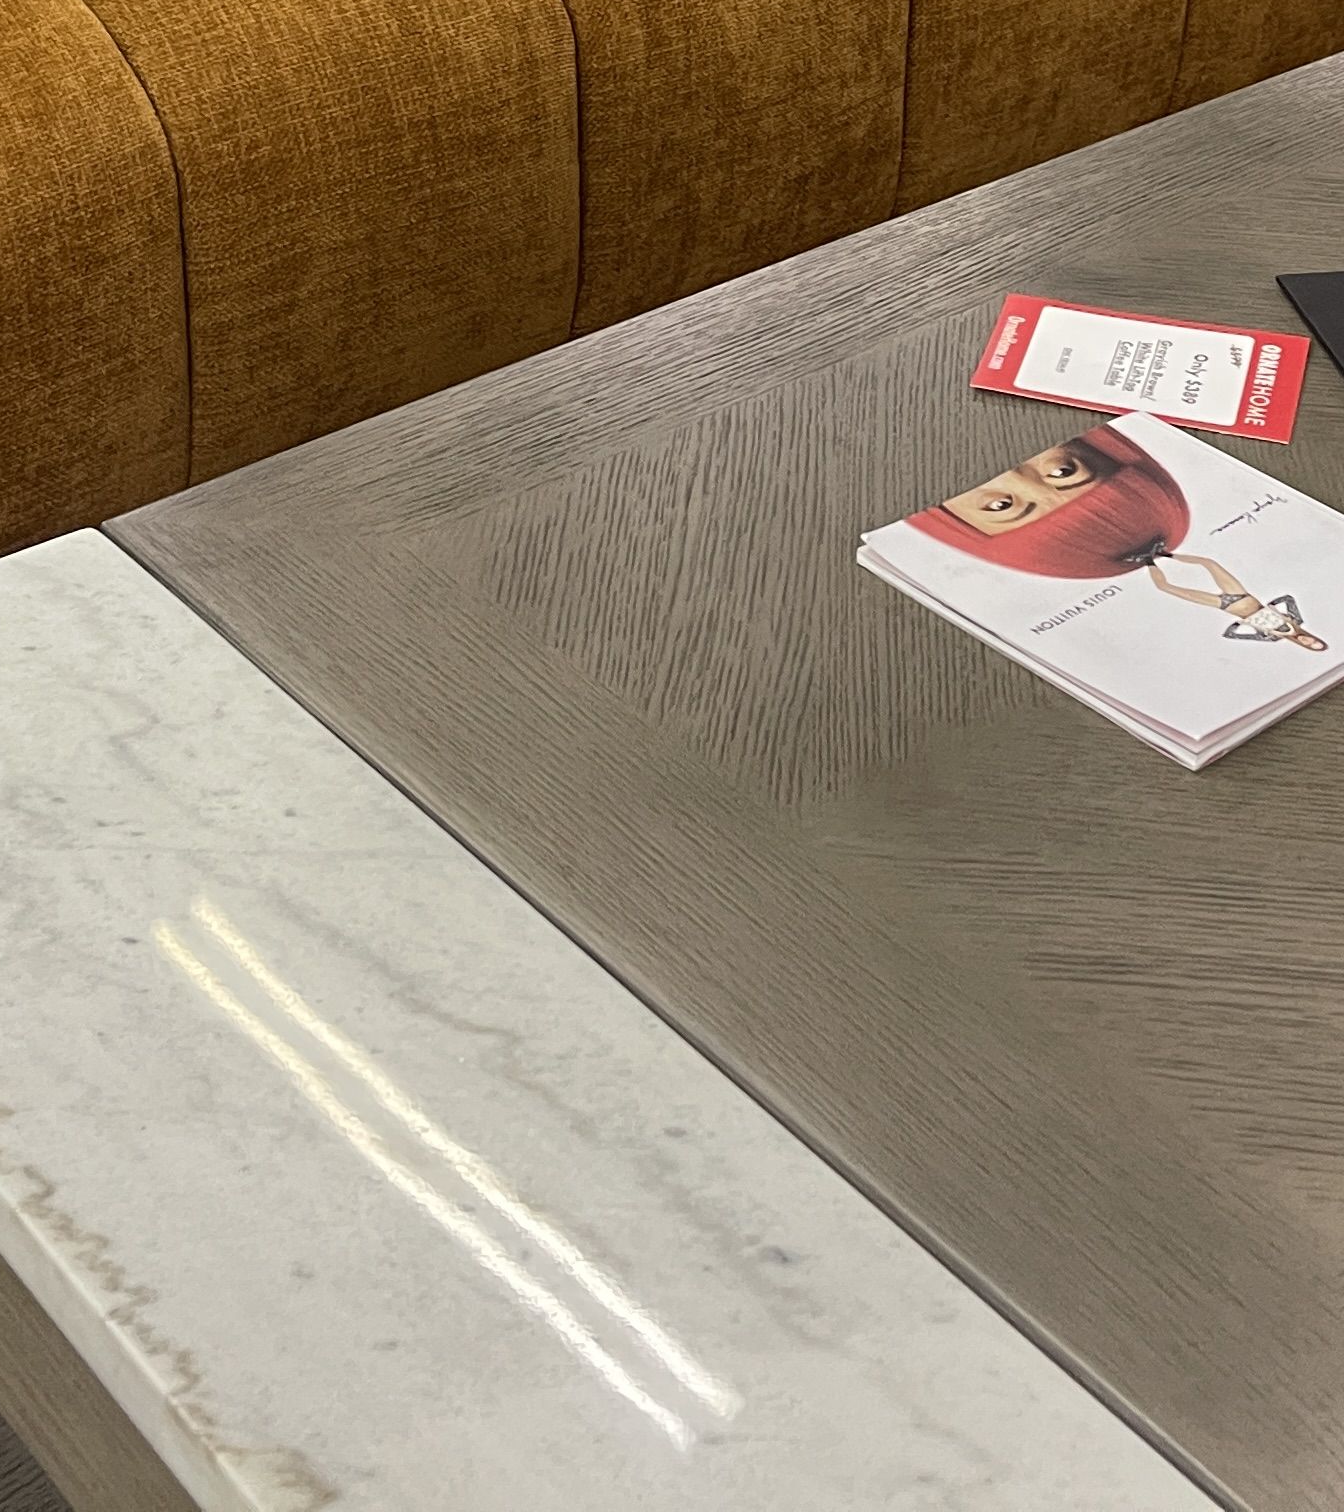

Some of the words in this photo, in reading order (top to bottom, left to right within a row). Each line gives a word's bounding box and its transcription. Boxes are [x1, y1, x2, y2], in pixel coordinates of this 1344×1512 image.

[1185, 353, 1209, 378] Only
[1181, 379, 1203, 405] $389
[1082, 584, 1123, 608] LOUIS
[1029, 605, 1088, 635] VUITTON
